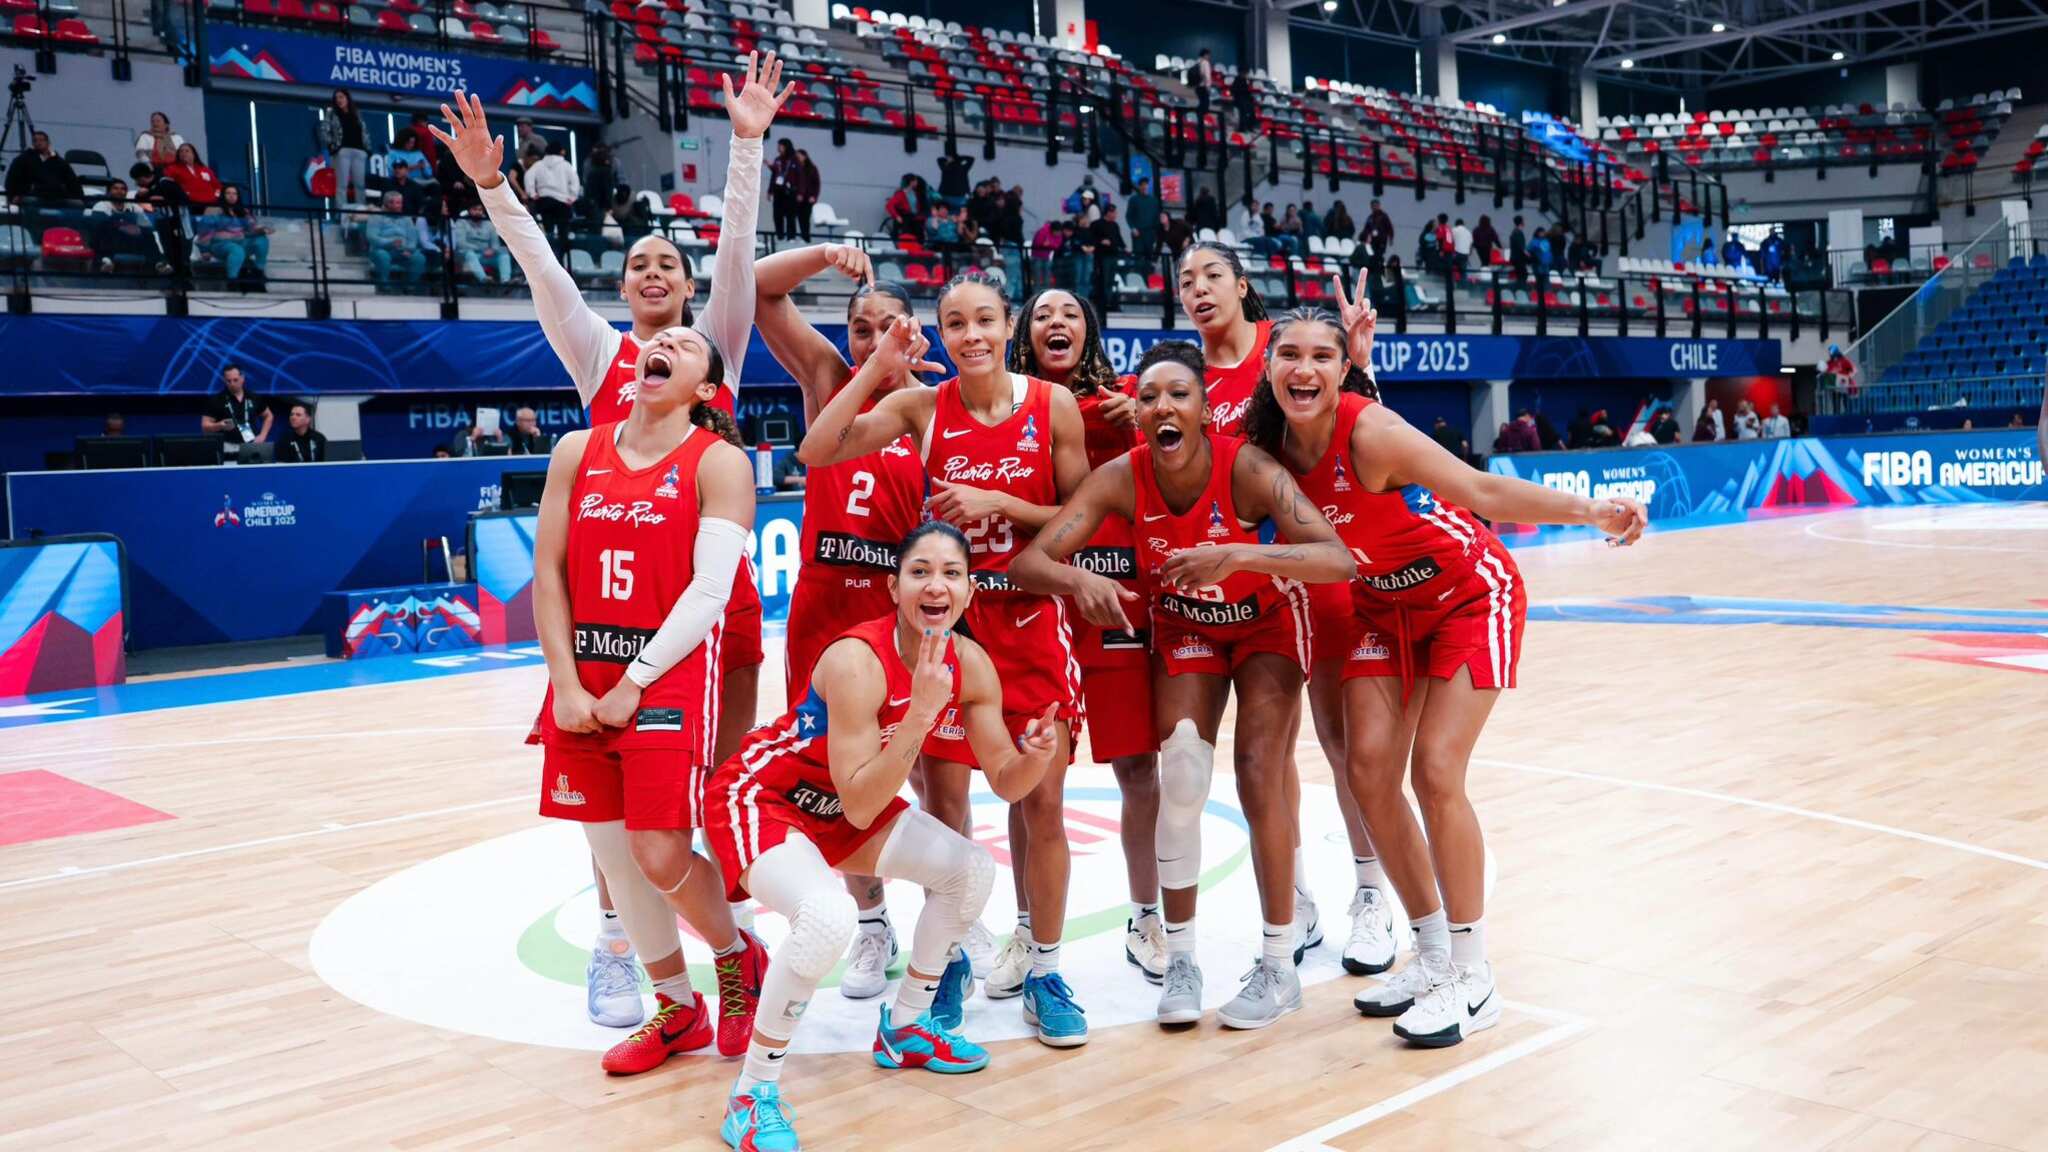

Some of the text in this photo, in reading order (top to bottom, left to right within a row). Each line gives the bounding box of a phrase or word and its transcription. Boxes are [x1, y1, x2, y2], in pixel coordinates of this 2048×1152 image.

[335, 46, 462, 76] FIBA WOMEN'S
[330, 64, 467, 93] AMERICUP 2025
[1102, 337, 1144, 374] BA
[1417, 341, 1470, 372] 2025
[1670, 343, 1718, 371] CHILE
[409, 402, 472, 429] FIBA
[1213, 398, 1252, 433] Puert
[1863, 450, 1933, 487] FIBA
[1955, 447, 2032, 461] WOMEN'S
[943, 456, 1035, 485] Puerto Rico
[1603, 466, 1646, 480] WOMEN'S
[846, 470, 875, 517] 2
[244, 505, 295, 518] AMERICUP
[577, 493, 666, 529] Puerto Rico
[1322, 504, 1355, 529] Rico
[599, 548, 635, 601] 15
[845, 579, 871, 588] PUR
[1183, 603, 1254, 624] Mobile
[591, 631, 646, 658] Mobil
